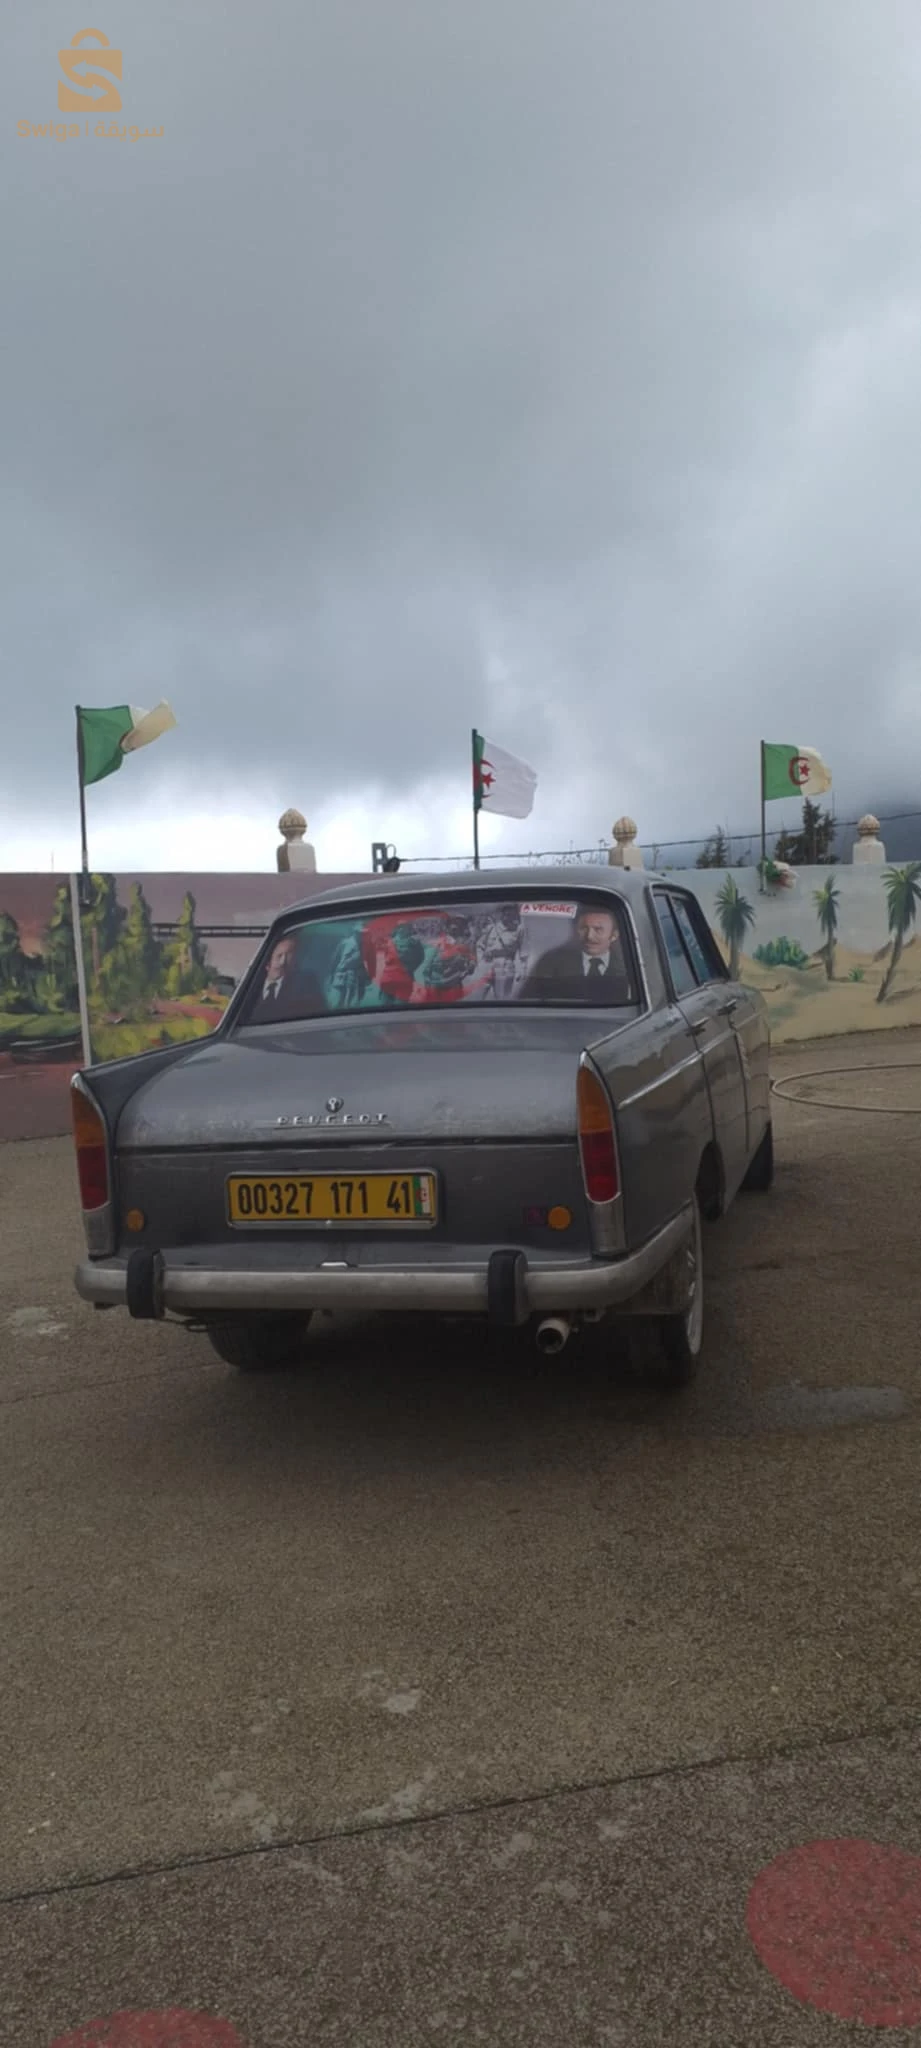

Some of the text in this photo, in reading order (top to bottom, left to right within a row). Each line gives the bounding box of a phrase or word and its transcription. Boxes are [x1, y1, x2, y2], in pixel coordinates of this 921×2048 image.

[533, 903, 573, 913] VENDRE
[276, 1113, 387, 1126] PEUGEOT
[238, 1181, 411, 1214] 00327 171 41
